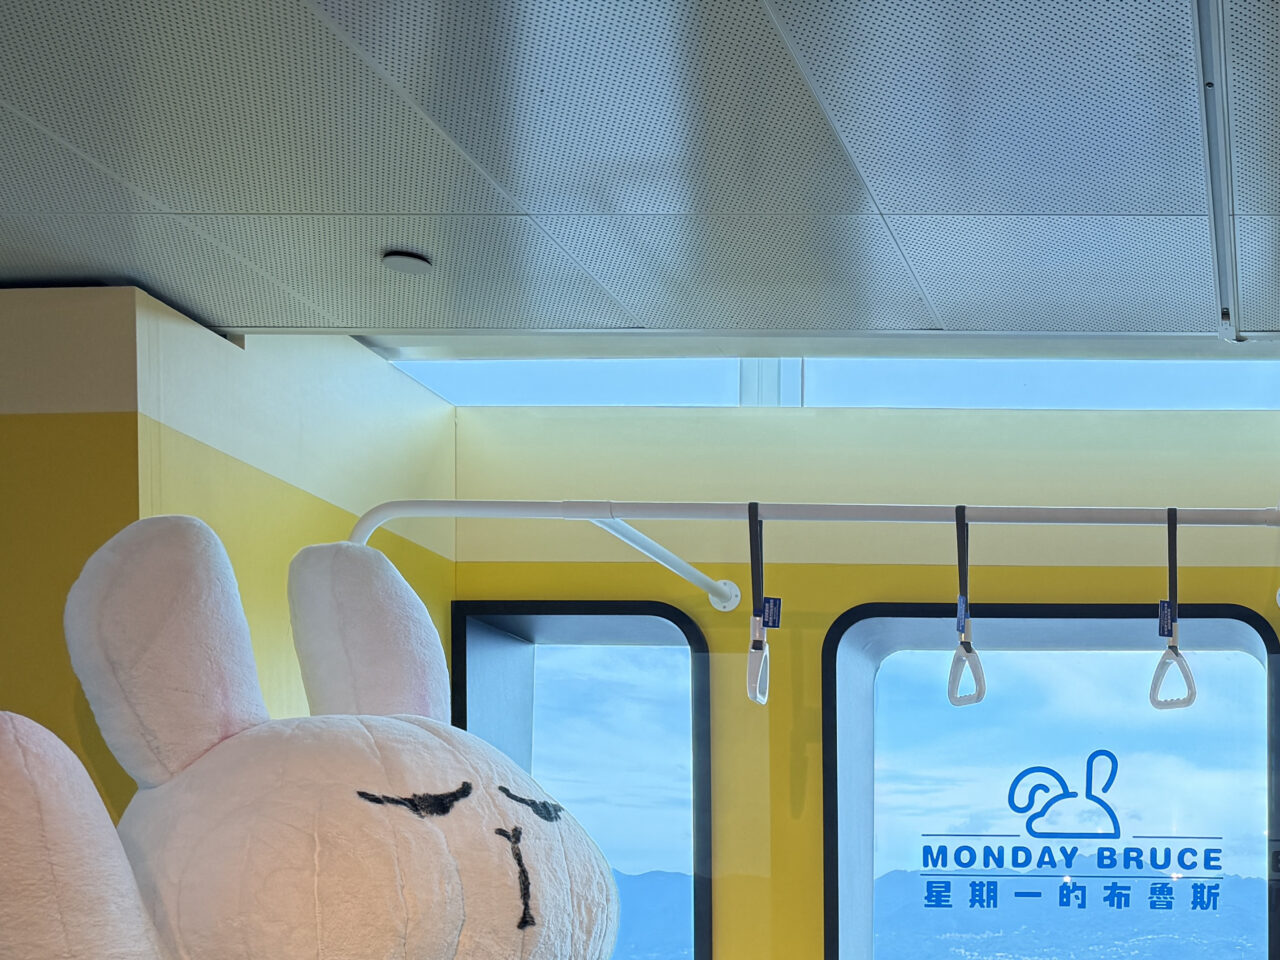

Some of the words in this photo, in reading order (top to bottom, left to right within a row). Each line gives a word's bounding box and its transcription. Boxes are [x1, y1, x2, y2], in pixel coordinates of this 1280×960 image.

[922, 844, 1079, 870] MONDAY
[1097, 846, 1223, 871] BRUCE
[923, 880, 1221, 911] 星期一的布魯斯
